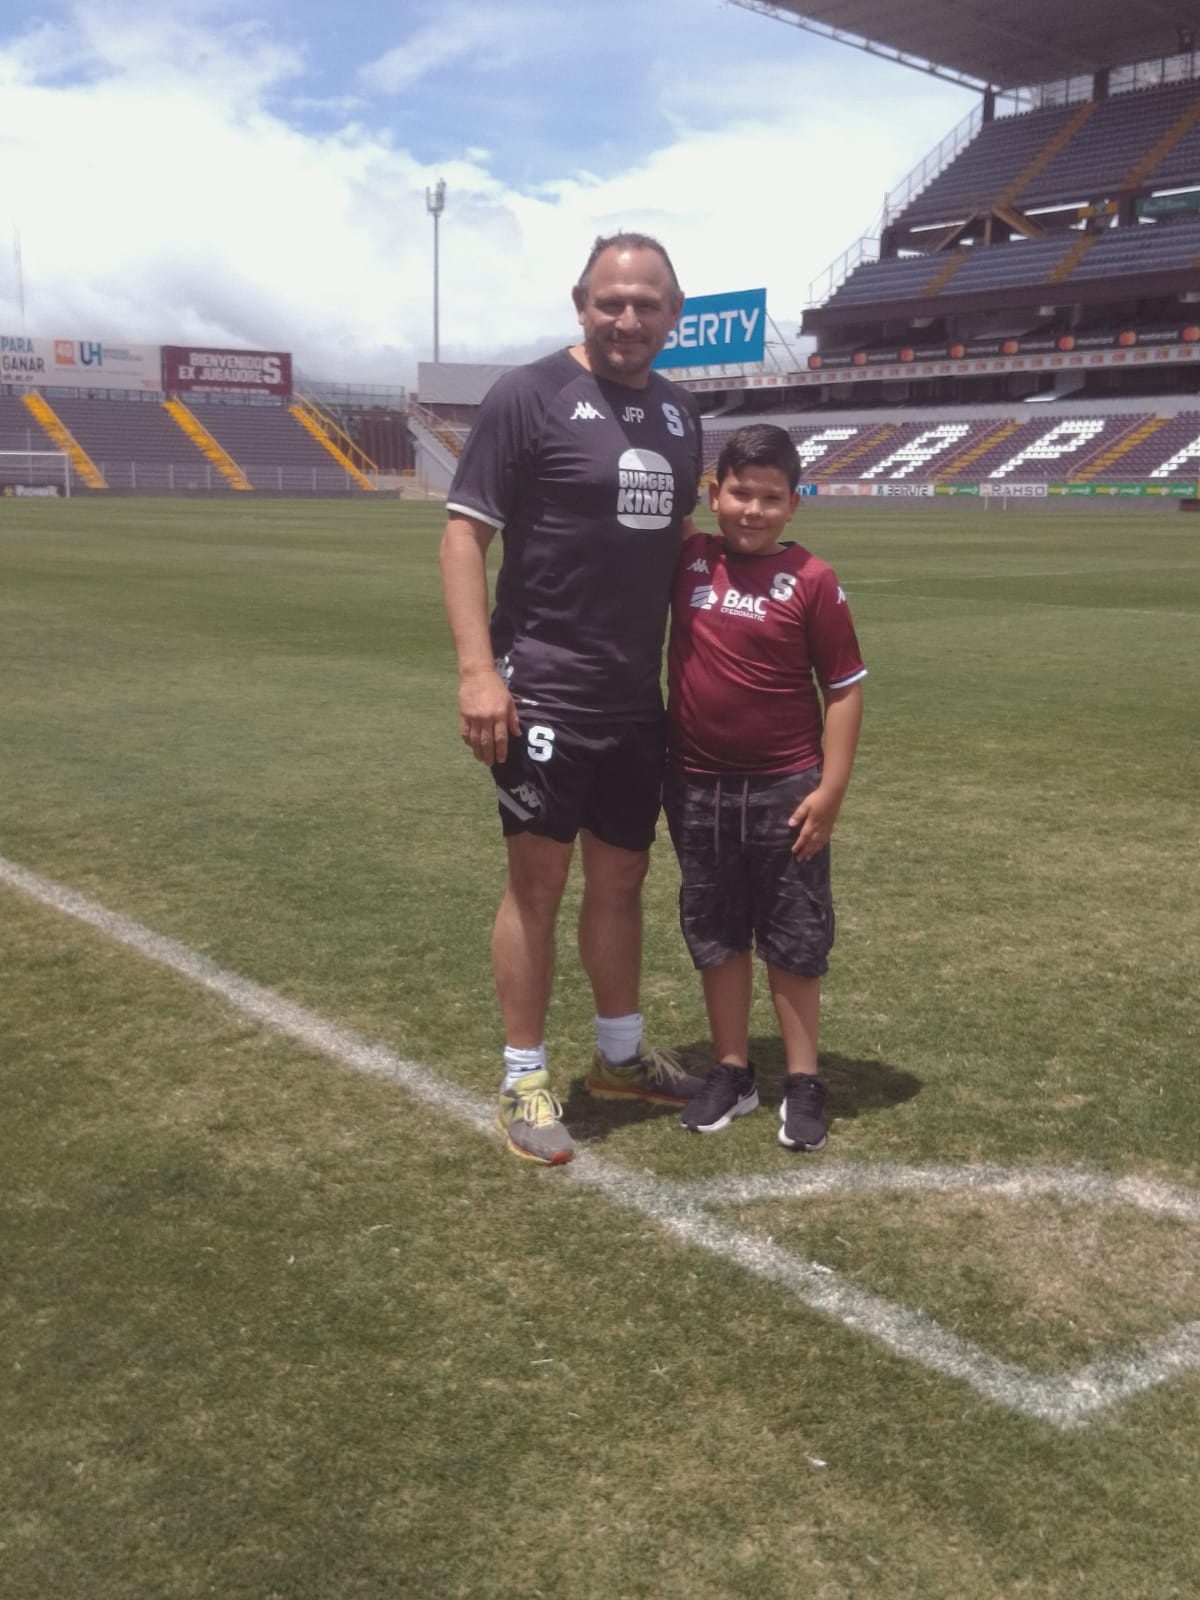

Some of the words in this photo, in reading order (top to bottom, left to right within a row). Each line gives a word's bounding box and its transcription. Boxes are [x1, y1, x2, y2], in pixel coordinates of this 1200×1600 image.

[1, 336, 34, 353] PARA
[80, 341, 103, 367] UH
[2, 355, 46, 374] GANAR
[178, 366, 195, 380] EX
[622, 406, 645, 423] JFP
[661, 402, 684, 437] S
[619, 471, 675, 491] BURGER
[617, 488, 674, 515] KING
[769, 572, 798, 603] S
[720, 606, 766, 622] CREDOMATIC
[722, 589, 770, 616] BAC
[527, 725, 556, 762] S
